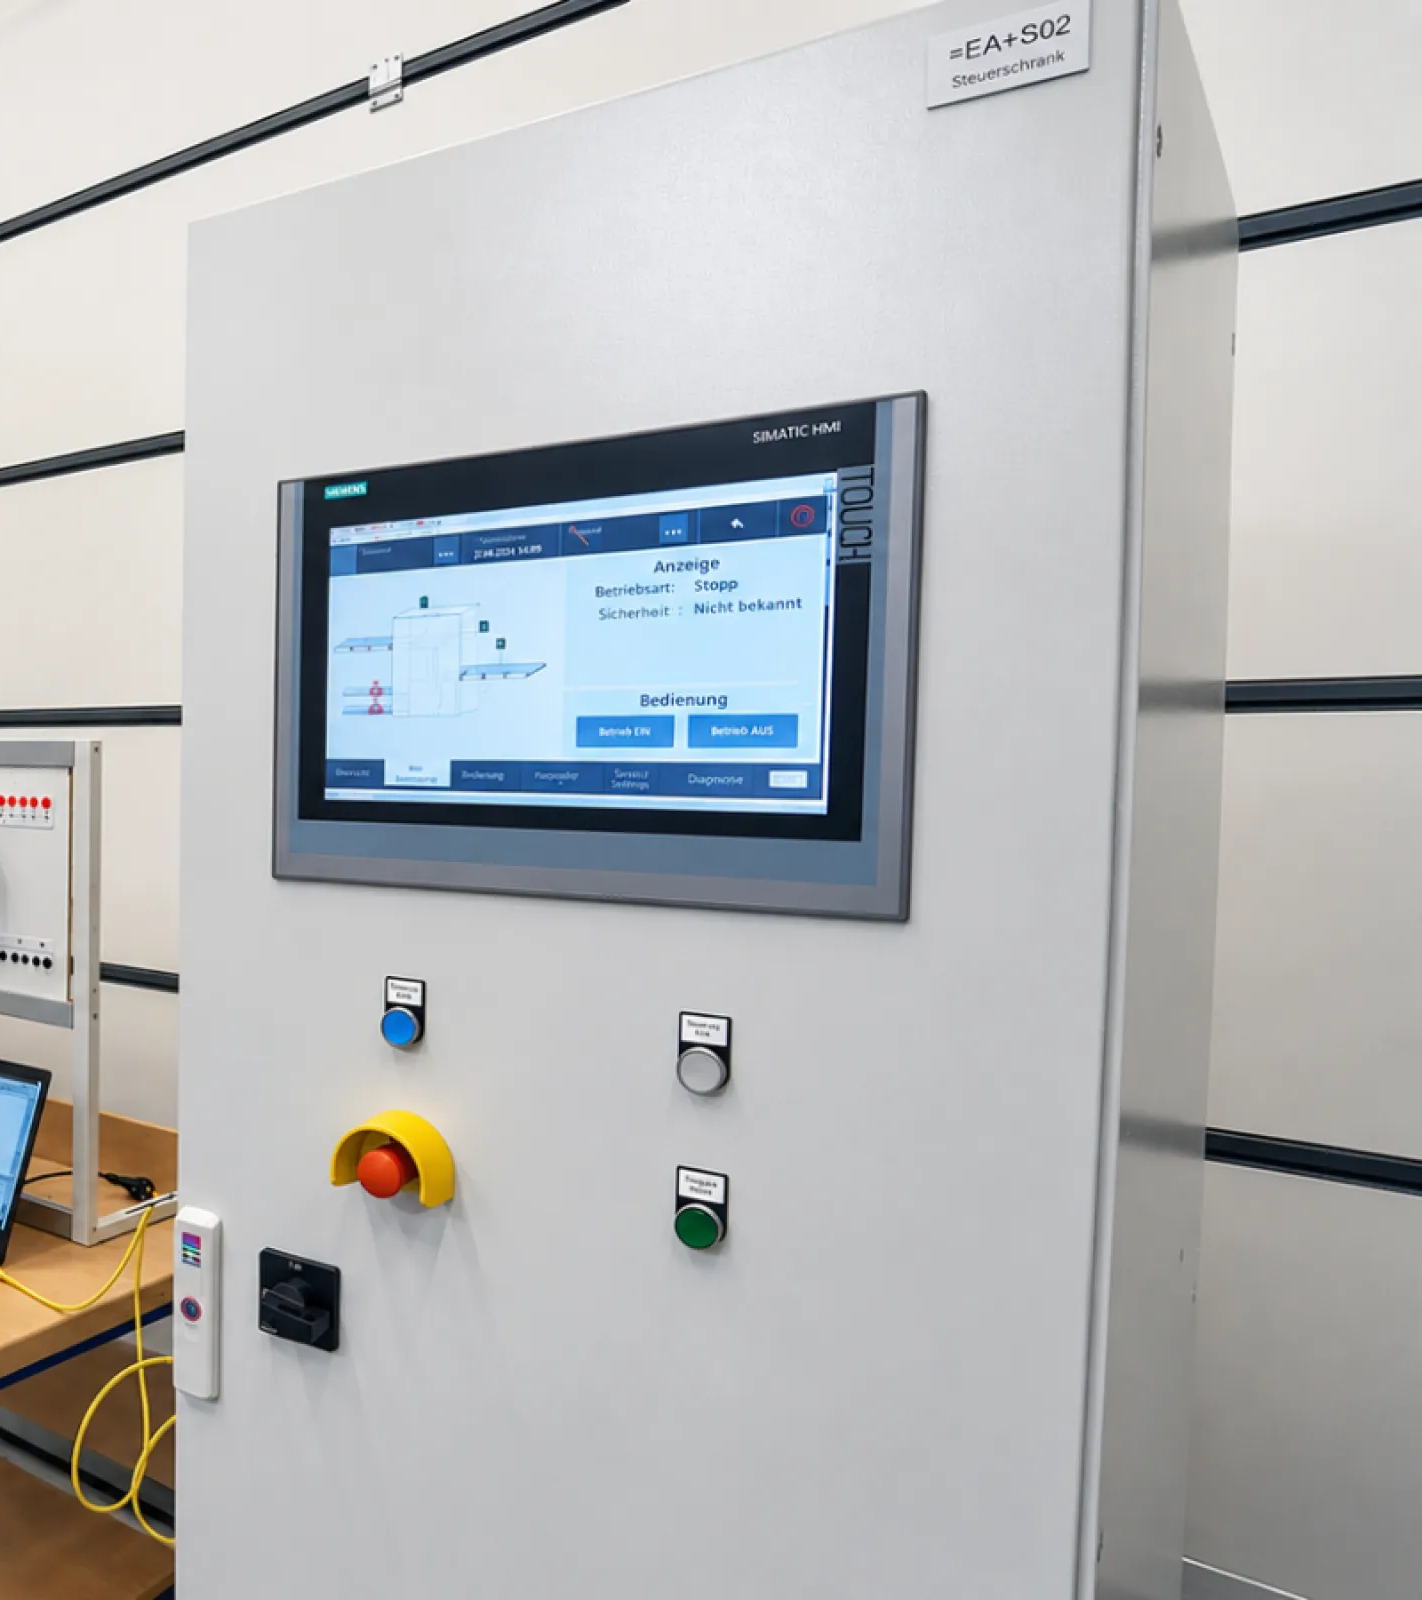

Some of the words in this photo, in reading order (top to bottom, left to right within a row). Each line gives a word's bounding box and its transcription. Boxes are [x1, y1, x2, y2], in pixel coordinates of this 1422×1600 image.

[949, 14, 1071, 61] =EA+S02
[951, 49, 1066, 89] Steuerschrank
[752, 424, 810, 444] SIMATIC
[811, 420, 842, 436] HMI
[838, 466, 875, 562] TOUCH
[653, 556, 721, 575] Anzeige
[594, 582, 676, 599] Betriebsart:
[694, 578, 739, 593] Stopp
[694, 600, 735, 615] Nicht
[738, 596, 803, 613] bekannt
[639, 692, 729, 710] Bedienung
[710, 725, 748, 737] Betrieb
[750, 724, 775, 736] AUS
